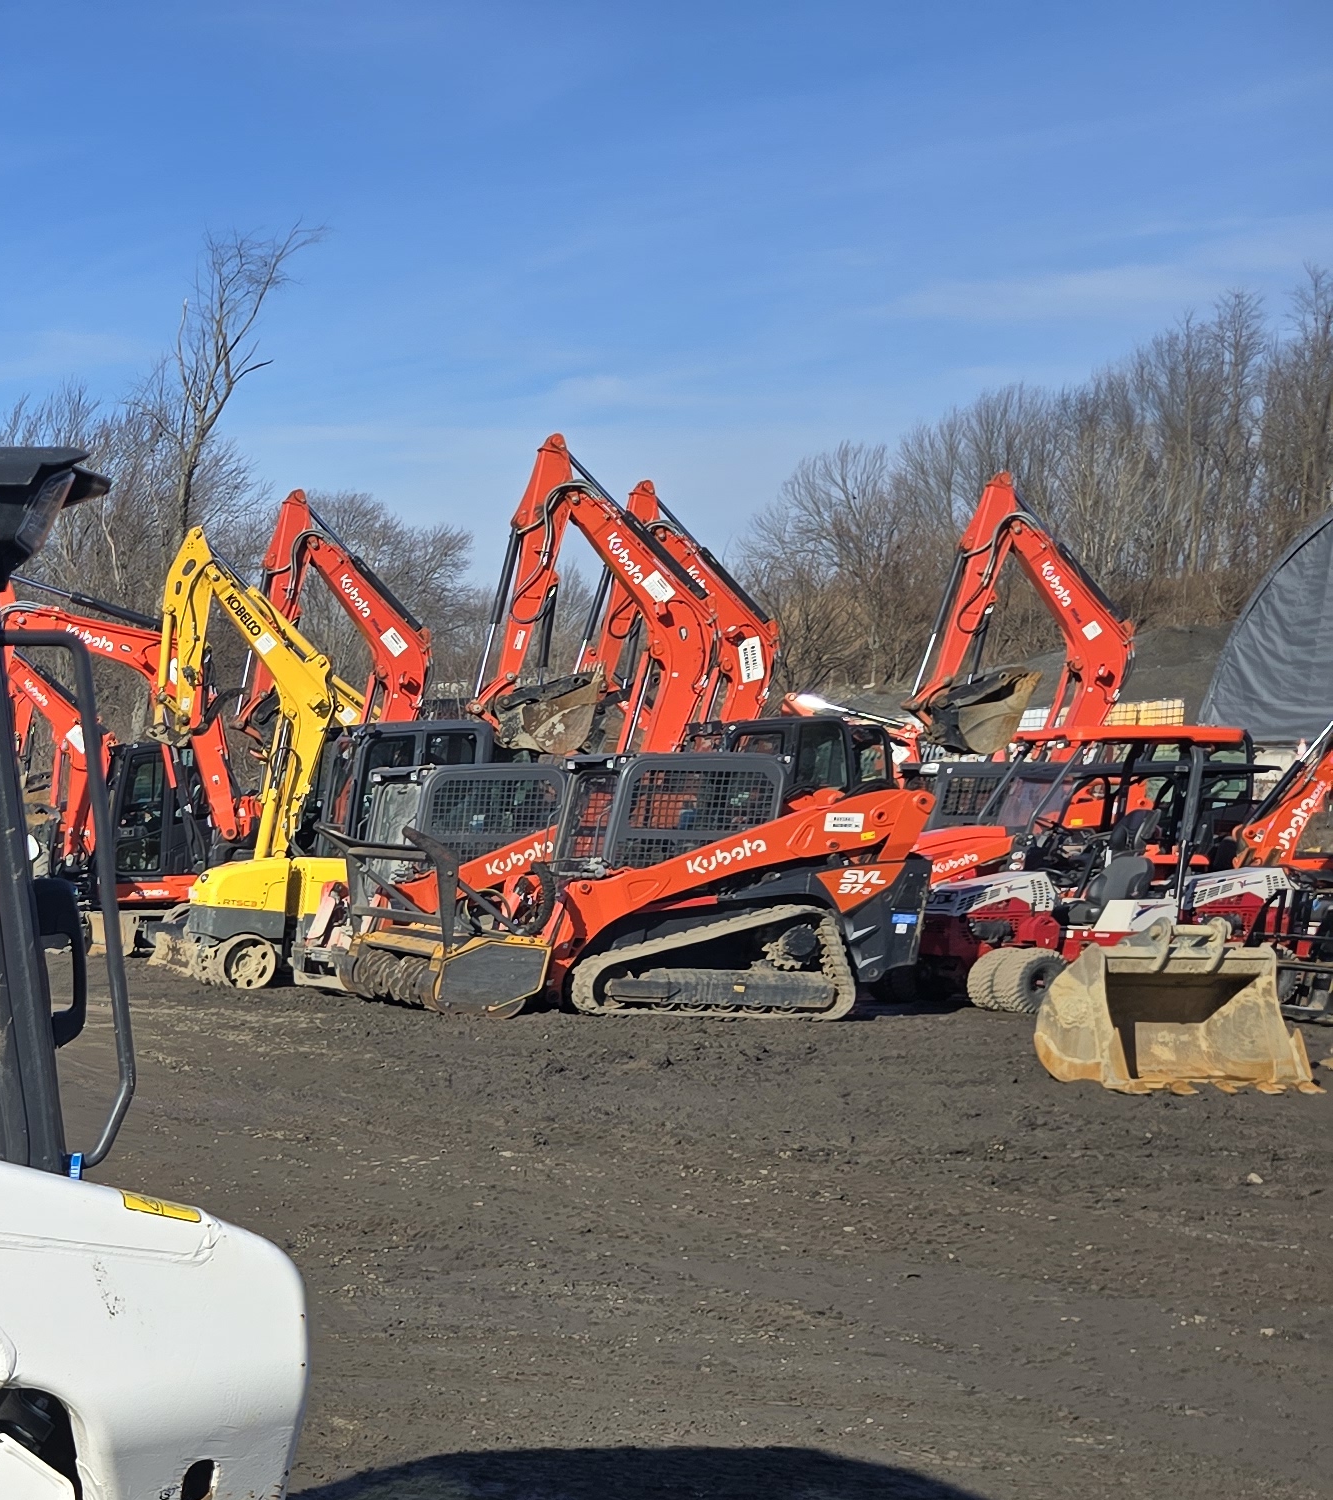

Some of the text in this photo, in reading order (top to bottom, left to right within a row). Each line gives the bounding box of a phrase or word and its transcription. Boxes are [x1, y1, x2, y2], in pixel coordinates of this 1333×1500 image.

[607, 532, 644, 585] Kubota
[340, 573, 371, 618] Kubota
[1041, 560, 1072, 607] Kubota
[224, 593, 262, 637] KOBELCO
[23, 678, 49, 707] Kubota
[485, 840, 554, 876] Kubota
[686, 838, 767, 875] Kubota
[932, 853, 979, 873] Kubota
[839, 869, 886, 884] SVL
